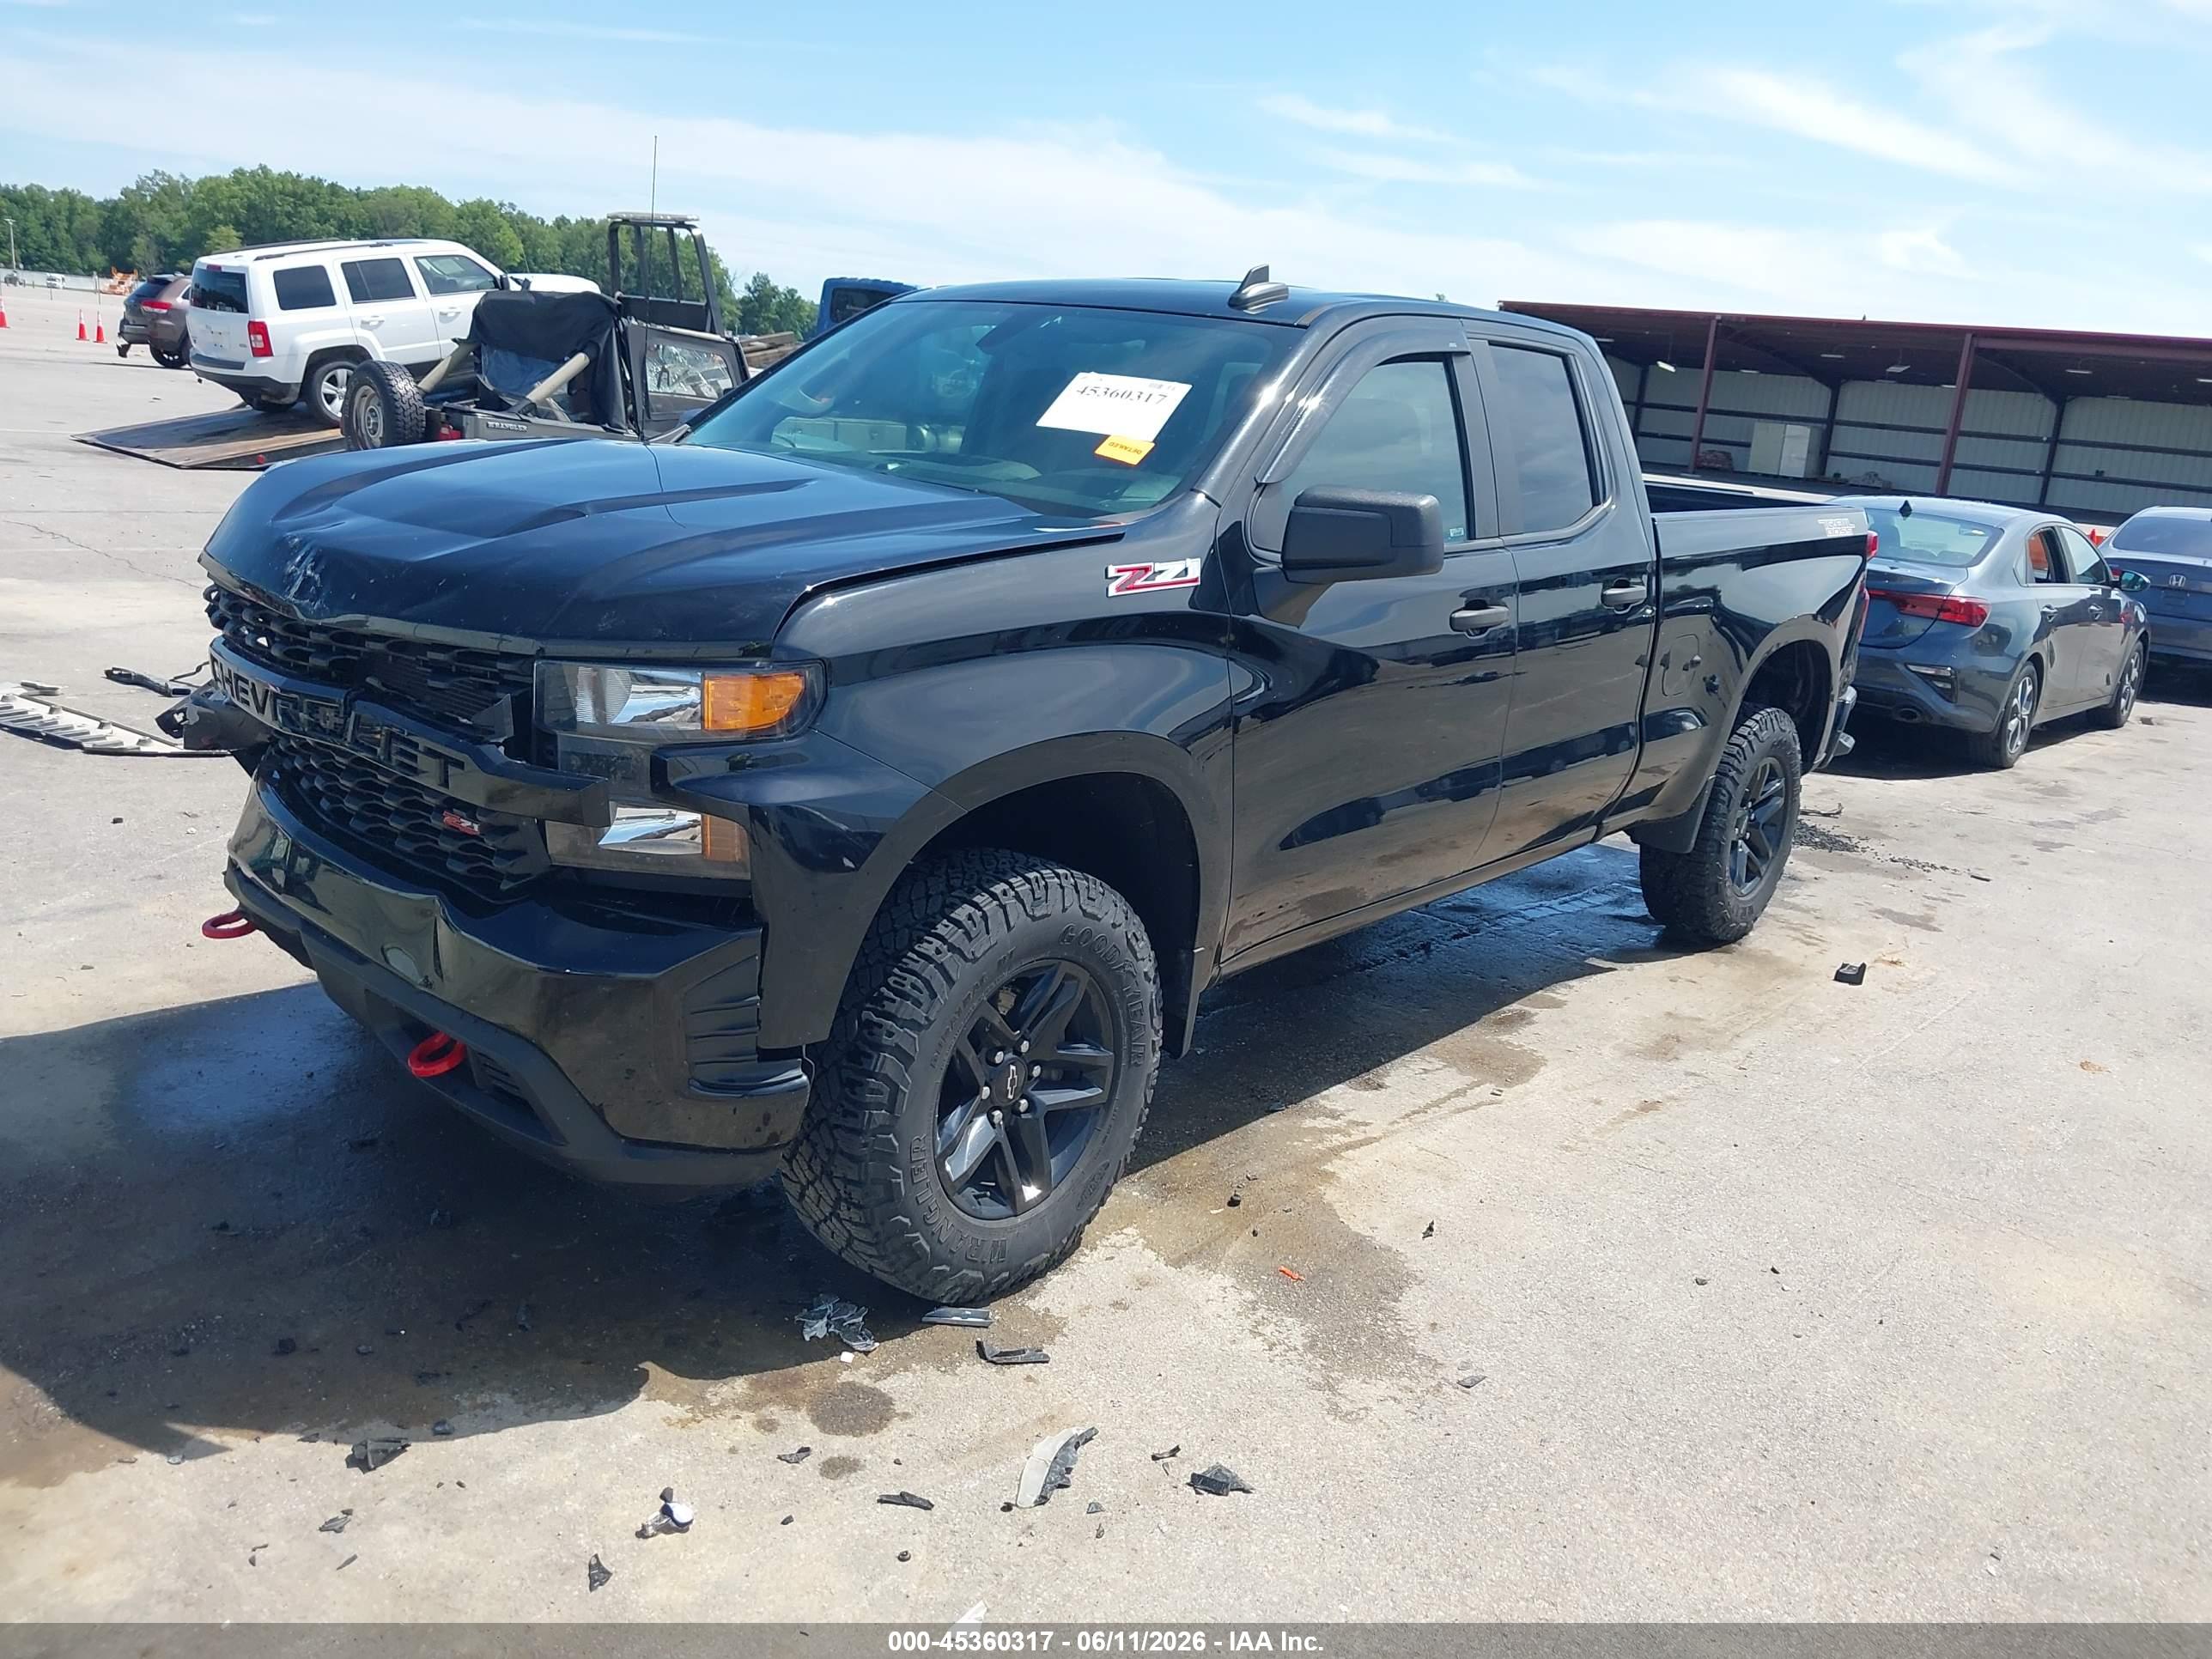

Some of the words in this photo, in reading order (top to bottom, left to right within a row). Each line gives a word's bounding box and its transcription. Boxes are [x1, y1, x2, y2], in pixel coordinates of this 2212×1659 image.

[1076, 386, 1168, 404] 45360317
[1105, 558, 1201, 597] Z71
[1058, 923, 1148, 1067] GOODYEAR
[908, 1133, 1008, 1265] WRANGLER
